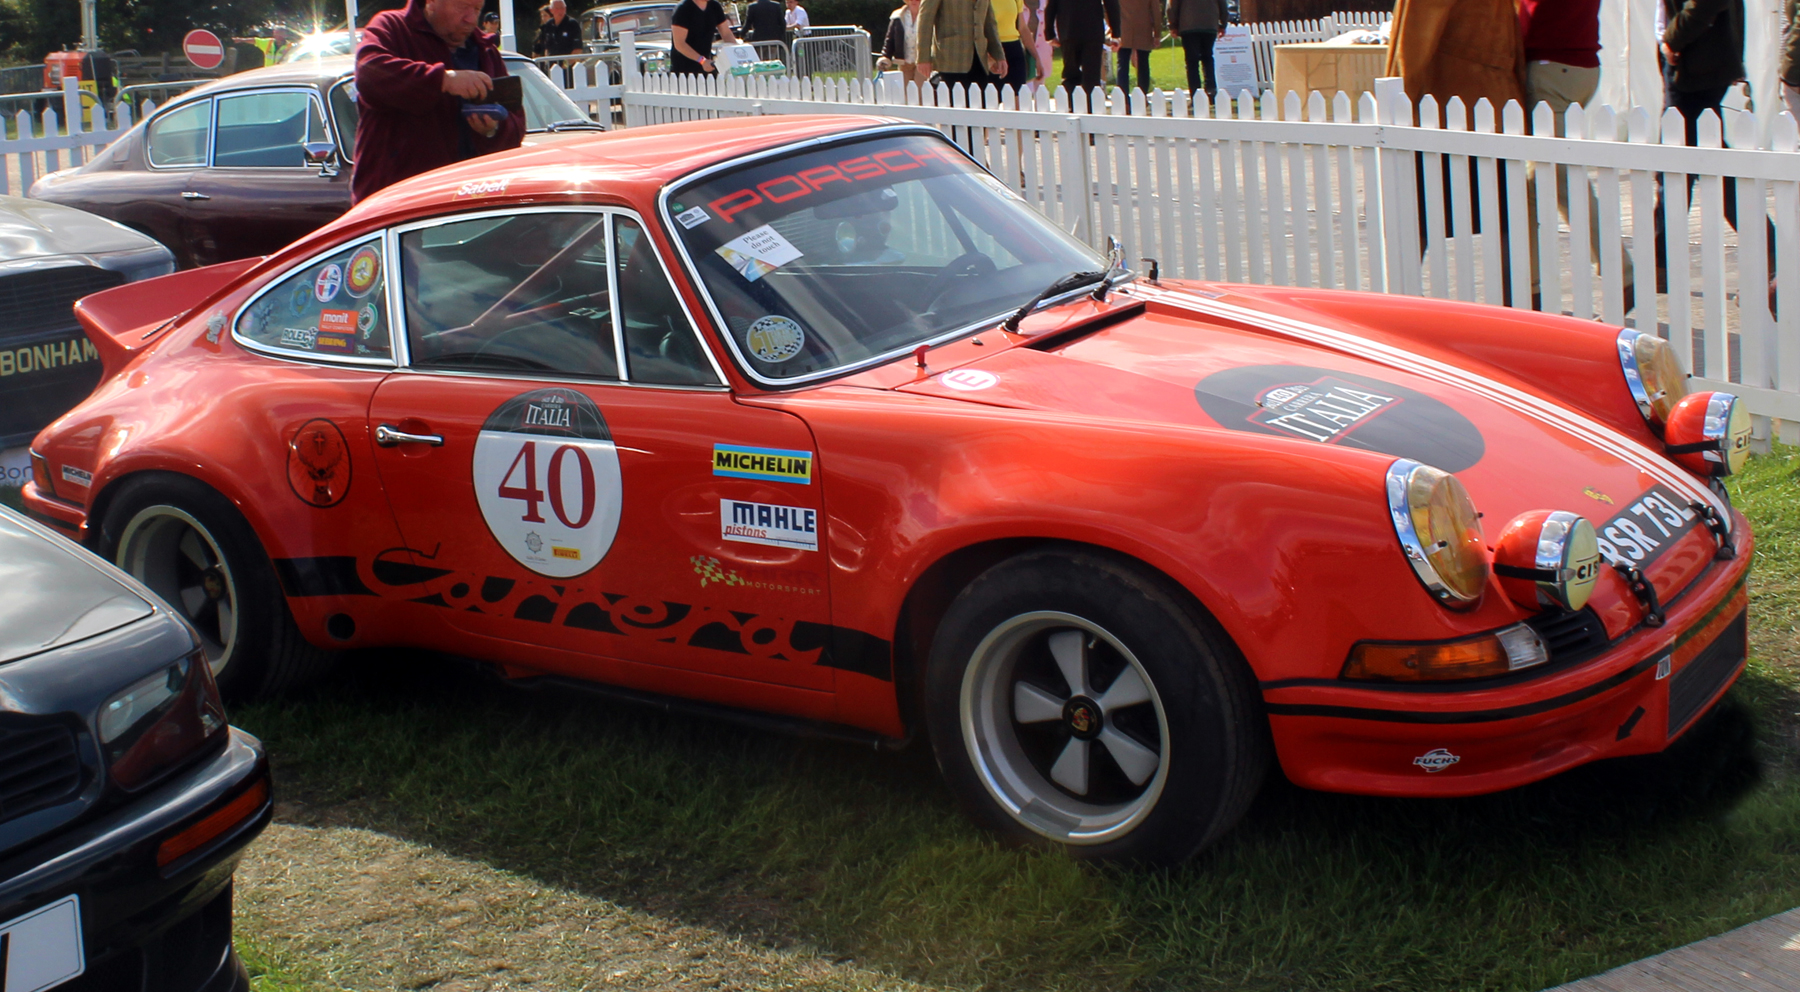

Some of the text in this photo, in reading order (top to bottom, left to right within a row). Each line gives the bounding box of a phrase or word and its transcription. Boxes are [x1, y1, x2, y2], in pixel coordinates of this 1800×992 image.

[708, 146, 973, 224] PORSCHE
[742, 230, 769, 244] Please
[751, 236, 775, 250] do not
[758, 242, 781, 255] touch
[323, 313, 349, 324] monit
[0, 338, 98, 376] BONHAM
[525, 404, 571, 427] ITALIA
[1265, 386, 1394, 442] ITALIA
[716, 452, 807, 475] MICHELIN
[498, 441, 596, 529] 40
[733, 502, 815, 533] MAHLE
[725, 524, 767, 539] pistons
[1596, 491, 1697, 568] RSR 73L
[746, 581, 822, 595] MOTORSPORT
[355, 542, 824, 664] Carrera
[1414, 756, 1459, 765] FUCHS
